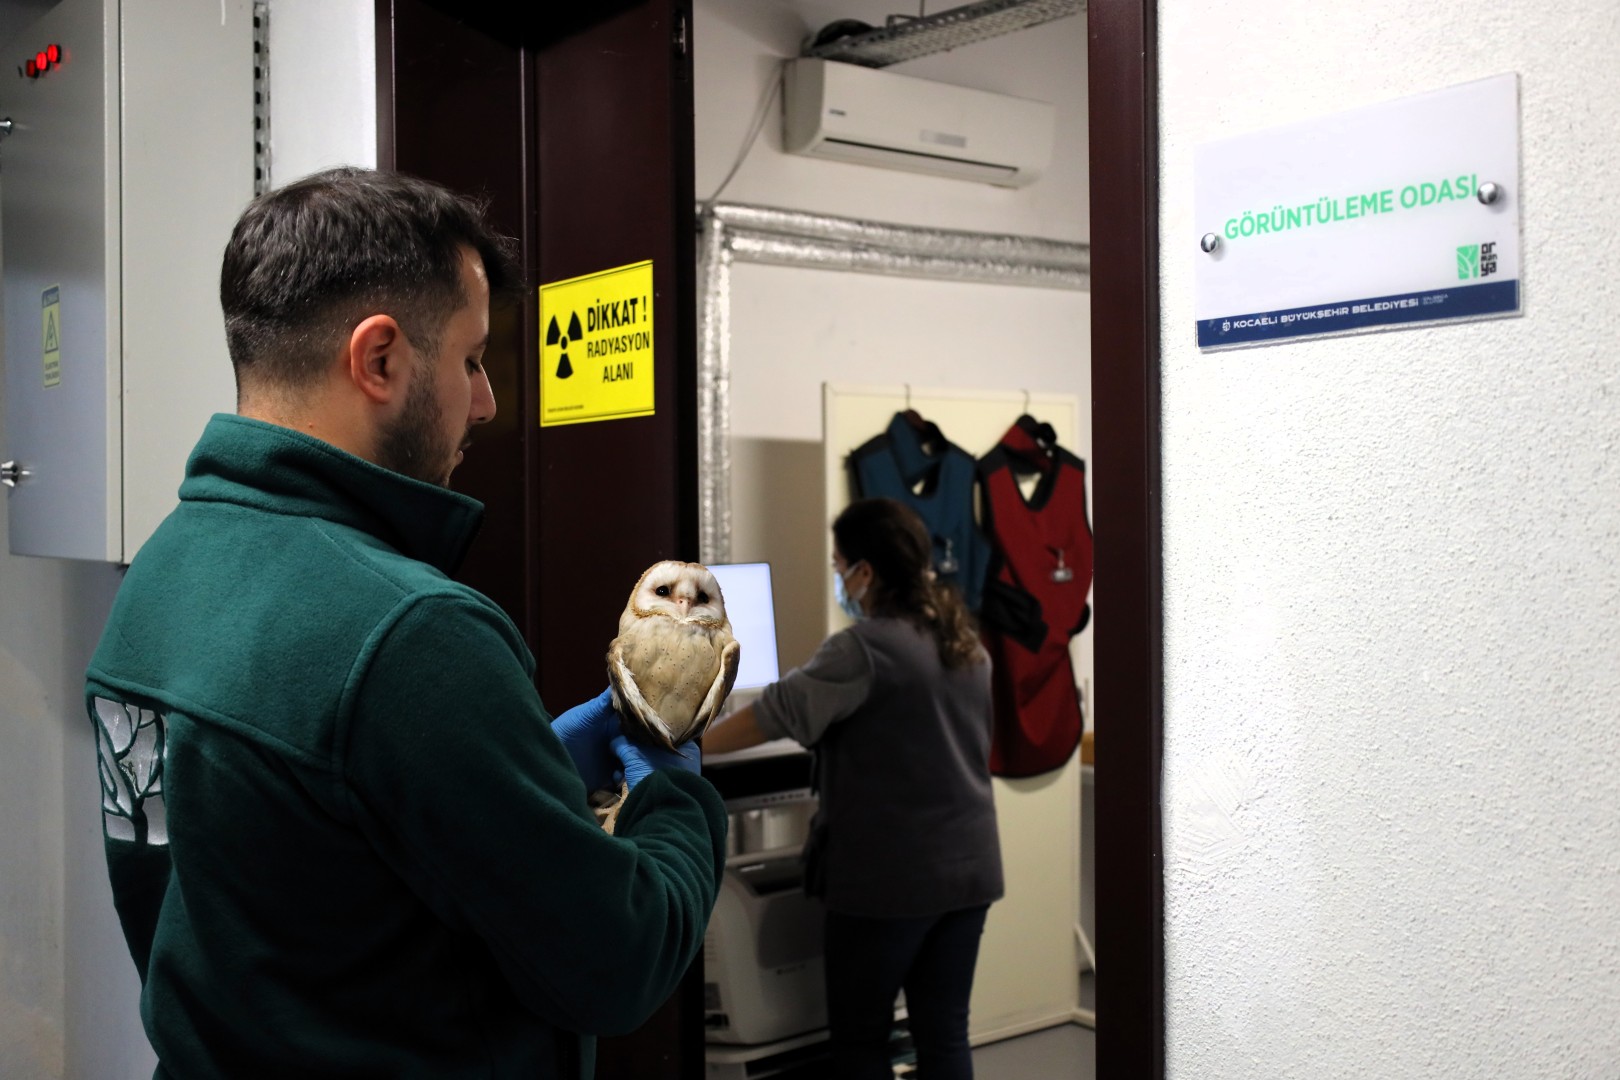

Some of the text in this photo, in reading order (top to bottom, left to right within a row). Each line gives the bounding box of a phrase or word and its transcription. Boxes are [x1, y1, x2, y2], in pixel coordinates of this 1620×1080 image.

[1224, 174, 1479, 240] GÖRÜNTÜLEME ODASI
[587, 298, 638, 332] DİKKAT
[1233, 316, 1278, 329] KOCAELİ
[1280, 307, 1349, 323] BÜYÜKŞEHİR
[1352, 298, 1419, 314] BELEDİYESİ
[588, 332, 650, 358] RADYASYON
[603, 362, 633, 383] ALANI
